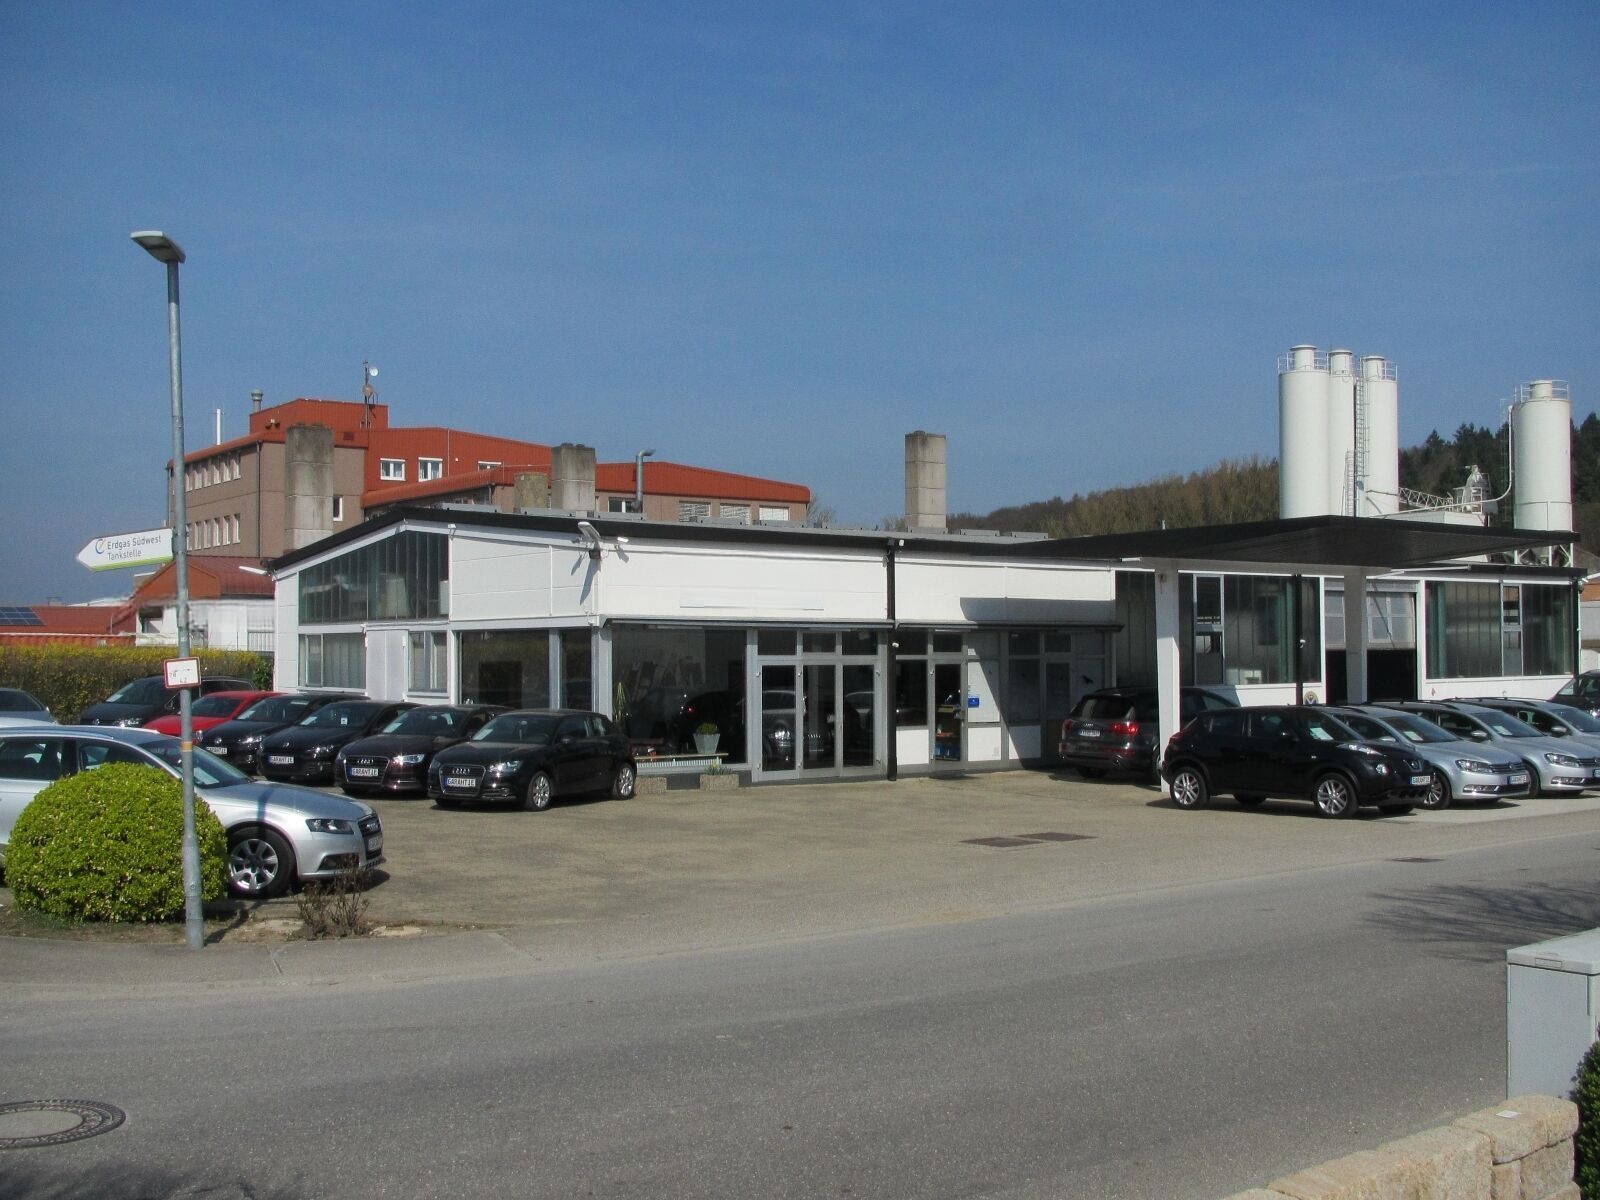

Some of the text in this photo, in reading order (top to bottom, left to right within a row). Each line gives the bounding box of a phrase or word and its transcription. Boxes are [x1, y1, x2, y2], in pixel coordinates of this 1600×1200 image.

[107, 535, 162, 550] Erdgas Südwest
[107, 549, 142, 560] Tankstelle
[447, 778, 475, 787] GARANTIE
